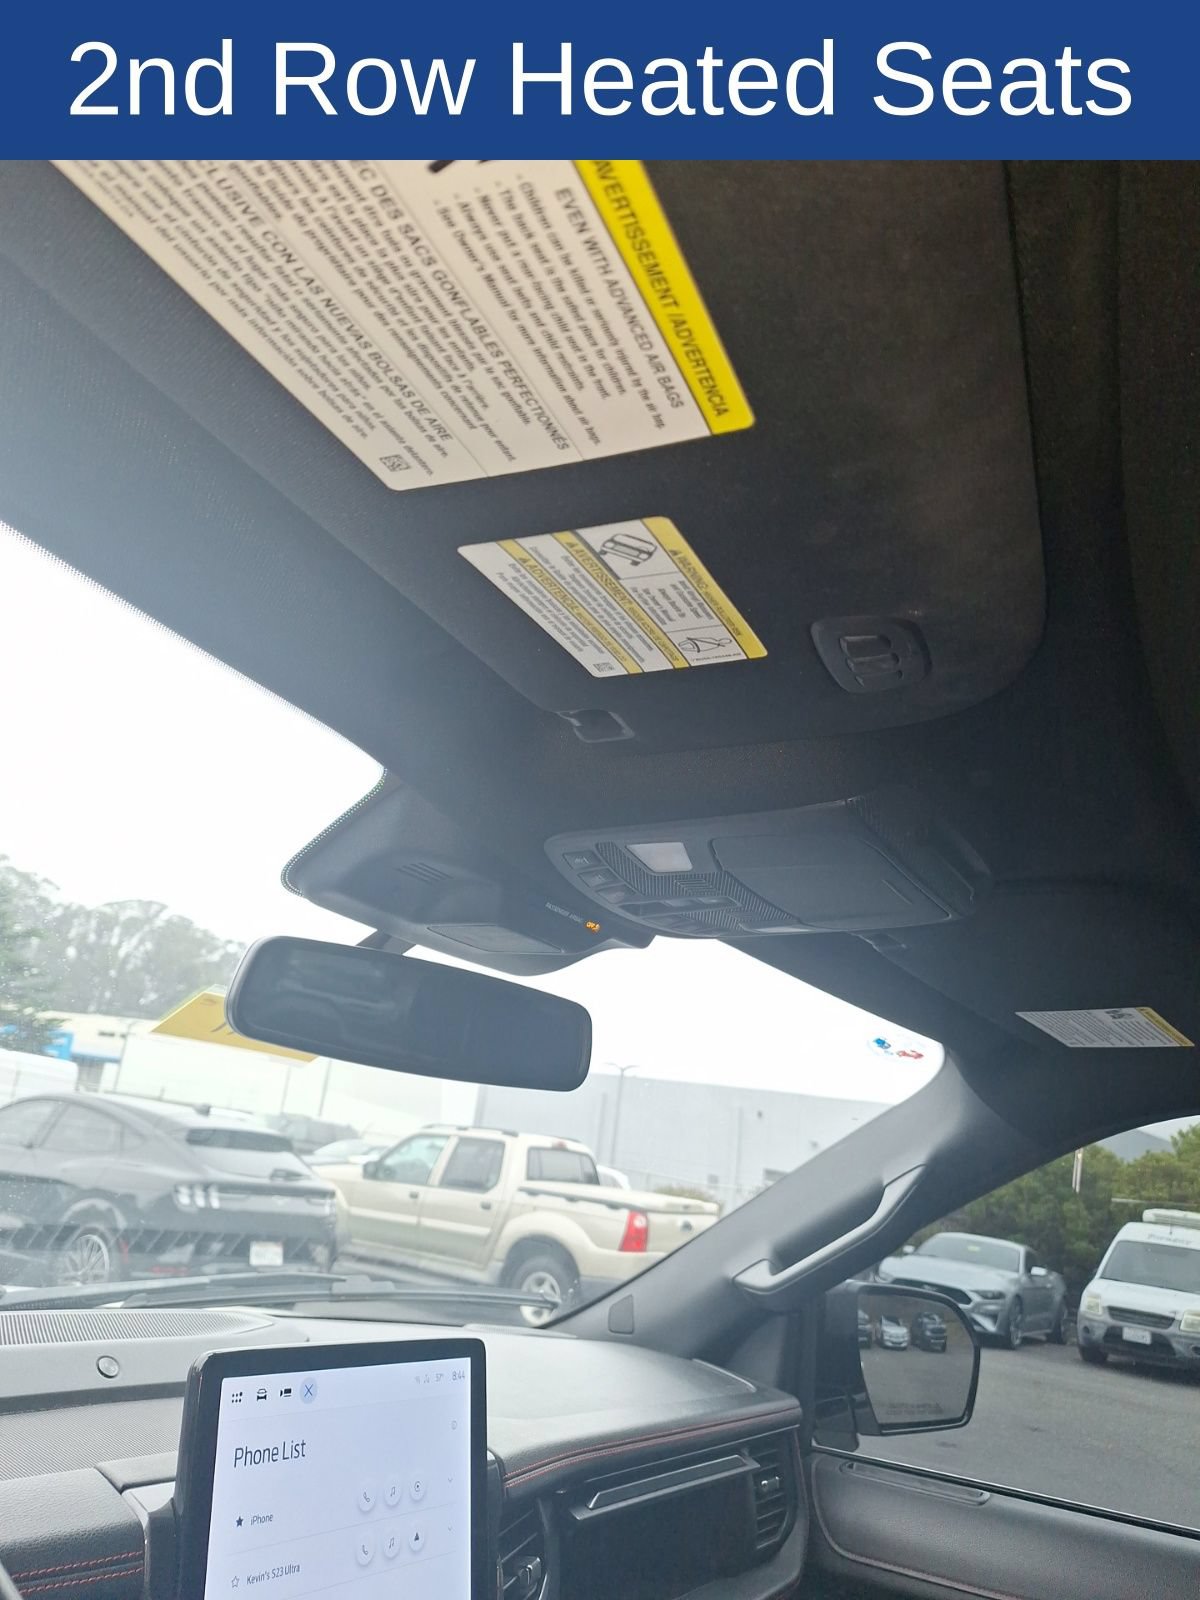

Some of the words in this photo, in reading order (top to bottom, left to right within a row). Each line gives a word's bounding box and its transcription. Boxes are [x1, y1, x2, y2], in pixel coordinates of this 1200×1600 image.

[590, 160, 678, 310] AVERTISSEMENT
[369, 184, 403, 219] DES
[397, 223, 437, 266] SACS
[430, 269, 504, 358] GONFLABLES
[496, 360, 570, 450] PERFECTIONNÉS
[553, 186, 591, 233] EVEN
[580, 236, 613, 275] WITH
[602, 277, 653, 351] ADVANCED
[643, 352, 666, 374] AIR
[656, 375, 684, 408] BAGS
[259, 230, 297, 264] CON
[291, 266, 325, 295] LAS
[318, 297, 373, 349] NUEVAS
[366, 351, 416, 398] BOLSAS
[423, 416, 454, 441] AIRE
[524, 563, 582, 611] ADVERTENCIA:
[571, 548, 635, 606] AVERTISSEMENT:
[452, 1370, 466, 1381] 8:44
[233, 1446, 279, 1468] Phone
[283, 1439, 306, 1460] List
[250, 1513, 274, 1526] iPhone
[246, 1570, 271, 1585] Kevin's
[271, 1566, 284, 1579] S23
[284, 1563, 301, 1576] Ultra
